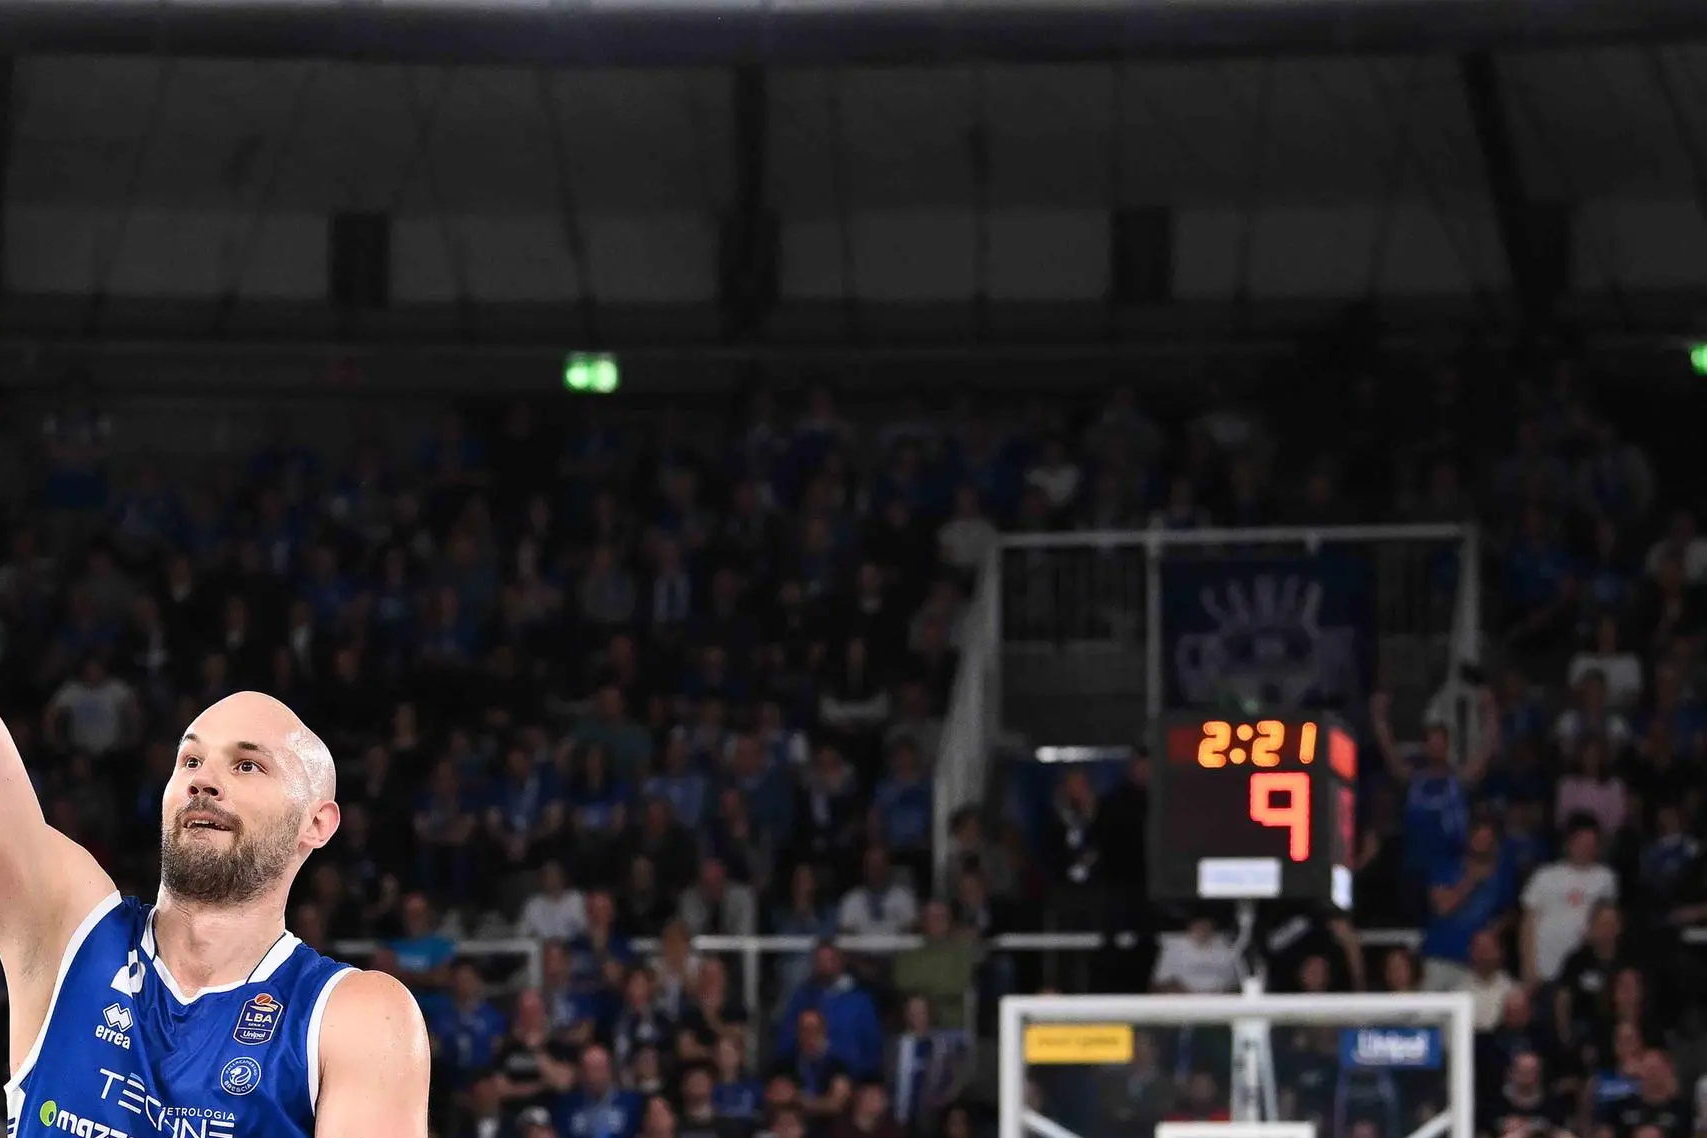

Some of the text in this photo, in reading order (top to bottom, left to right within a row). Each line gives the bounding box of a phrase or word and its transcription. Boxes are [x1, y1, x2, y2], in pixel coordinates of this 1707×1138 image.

[1197, 719, 1317, 768] 2:21
[1250, 771, 1311, 861] 9
[244, 1012, 273, 1024] LBA
[95, 1024, 131, 1050] errea
[242, 1030, 266, 1040] Unipol
[224, 1080, 252, 1093] BRESCIA
